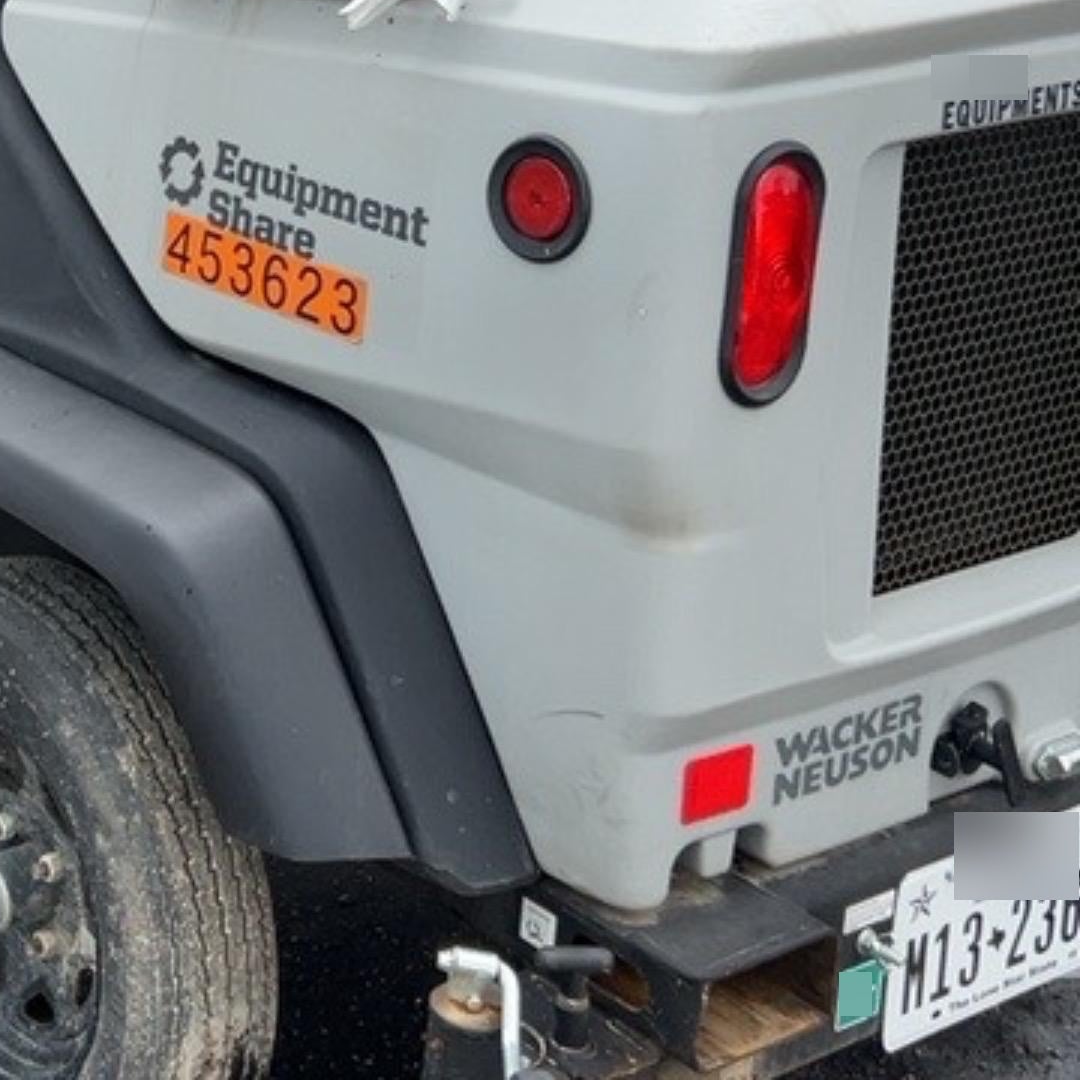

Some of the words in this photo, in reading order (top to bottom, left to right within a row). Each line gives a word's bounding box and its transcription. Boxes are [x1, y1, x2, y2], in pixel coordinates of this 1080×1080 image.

[207, 188, 317, 259] Share
[213, 139, 430, 247] Equipment
[167, 222, 359, 336] 453623
[773, 726, 921, 806] NEUSON
[776, 694, 923, 766] WACKER
